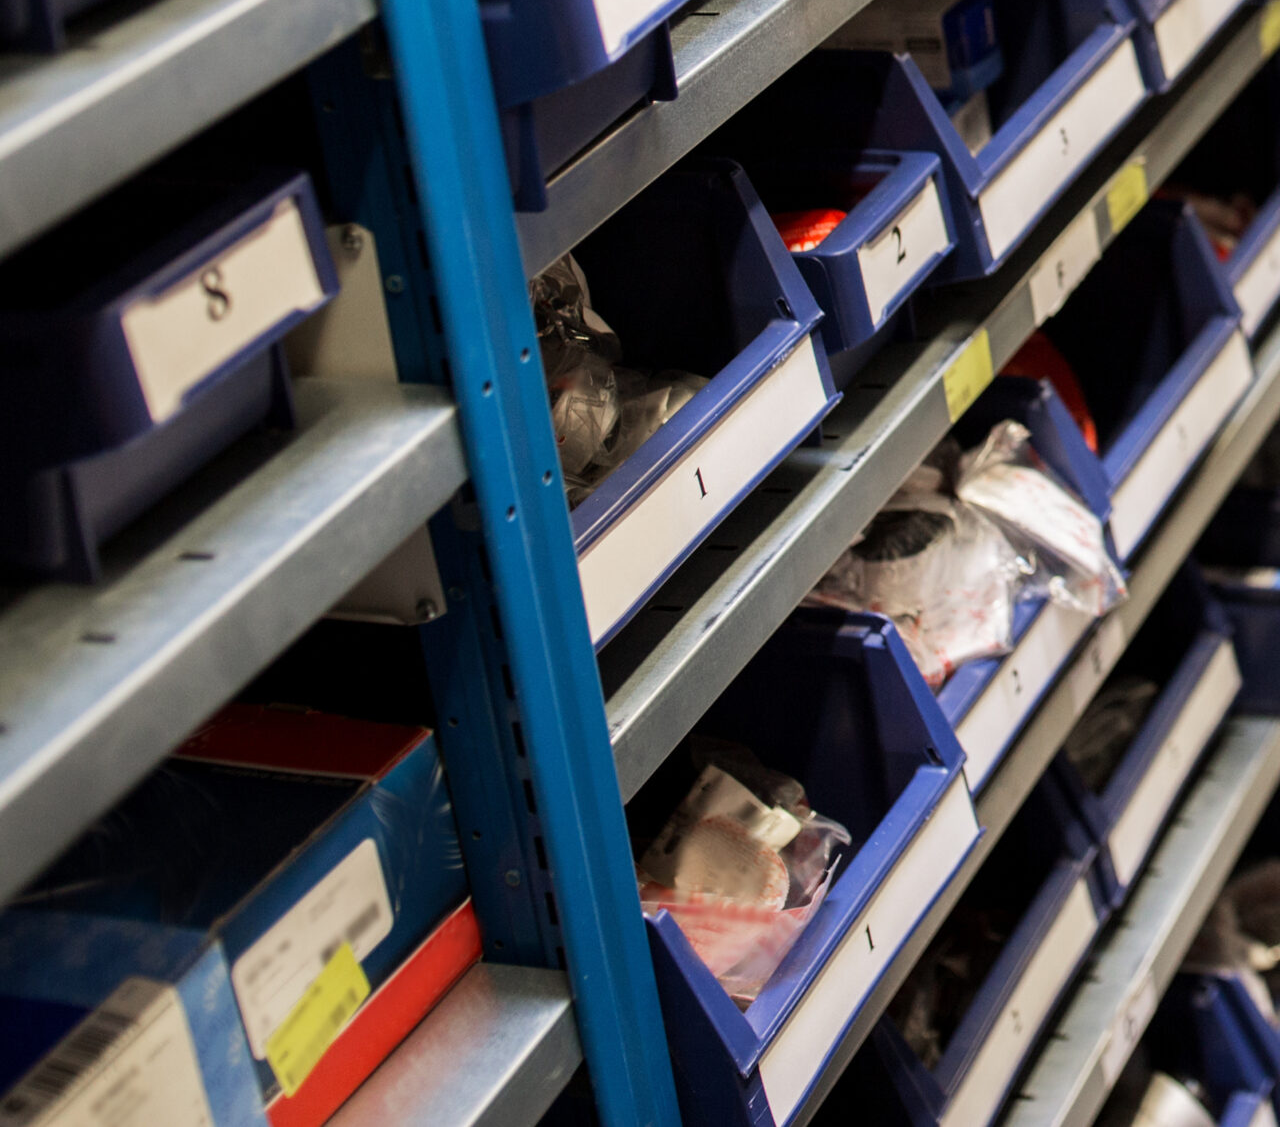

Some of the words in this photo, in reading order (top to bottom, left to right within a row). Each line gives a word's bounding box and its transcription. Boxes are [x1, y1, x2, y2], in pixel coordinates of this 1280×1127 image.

[891, 225, 907, 265] 2
[200, 264, 232, 322] 8
[694, 467, 708, 500] 1
[865, 924, 875, 952] 1
